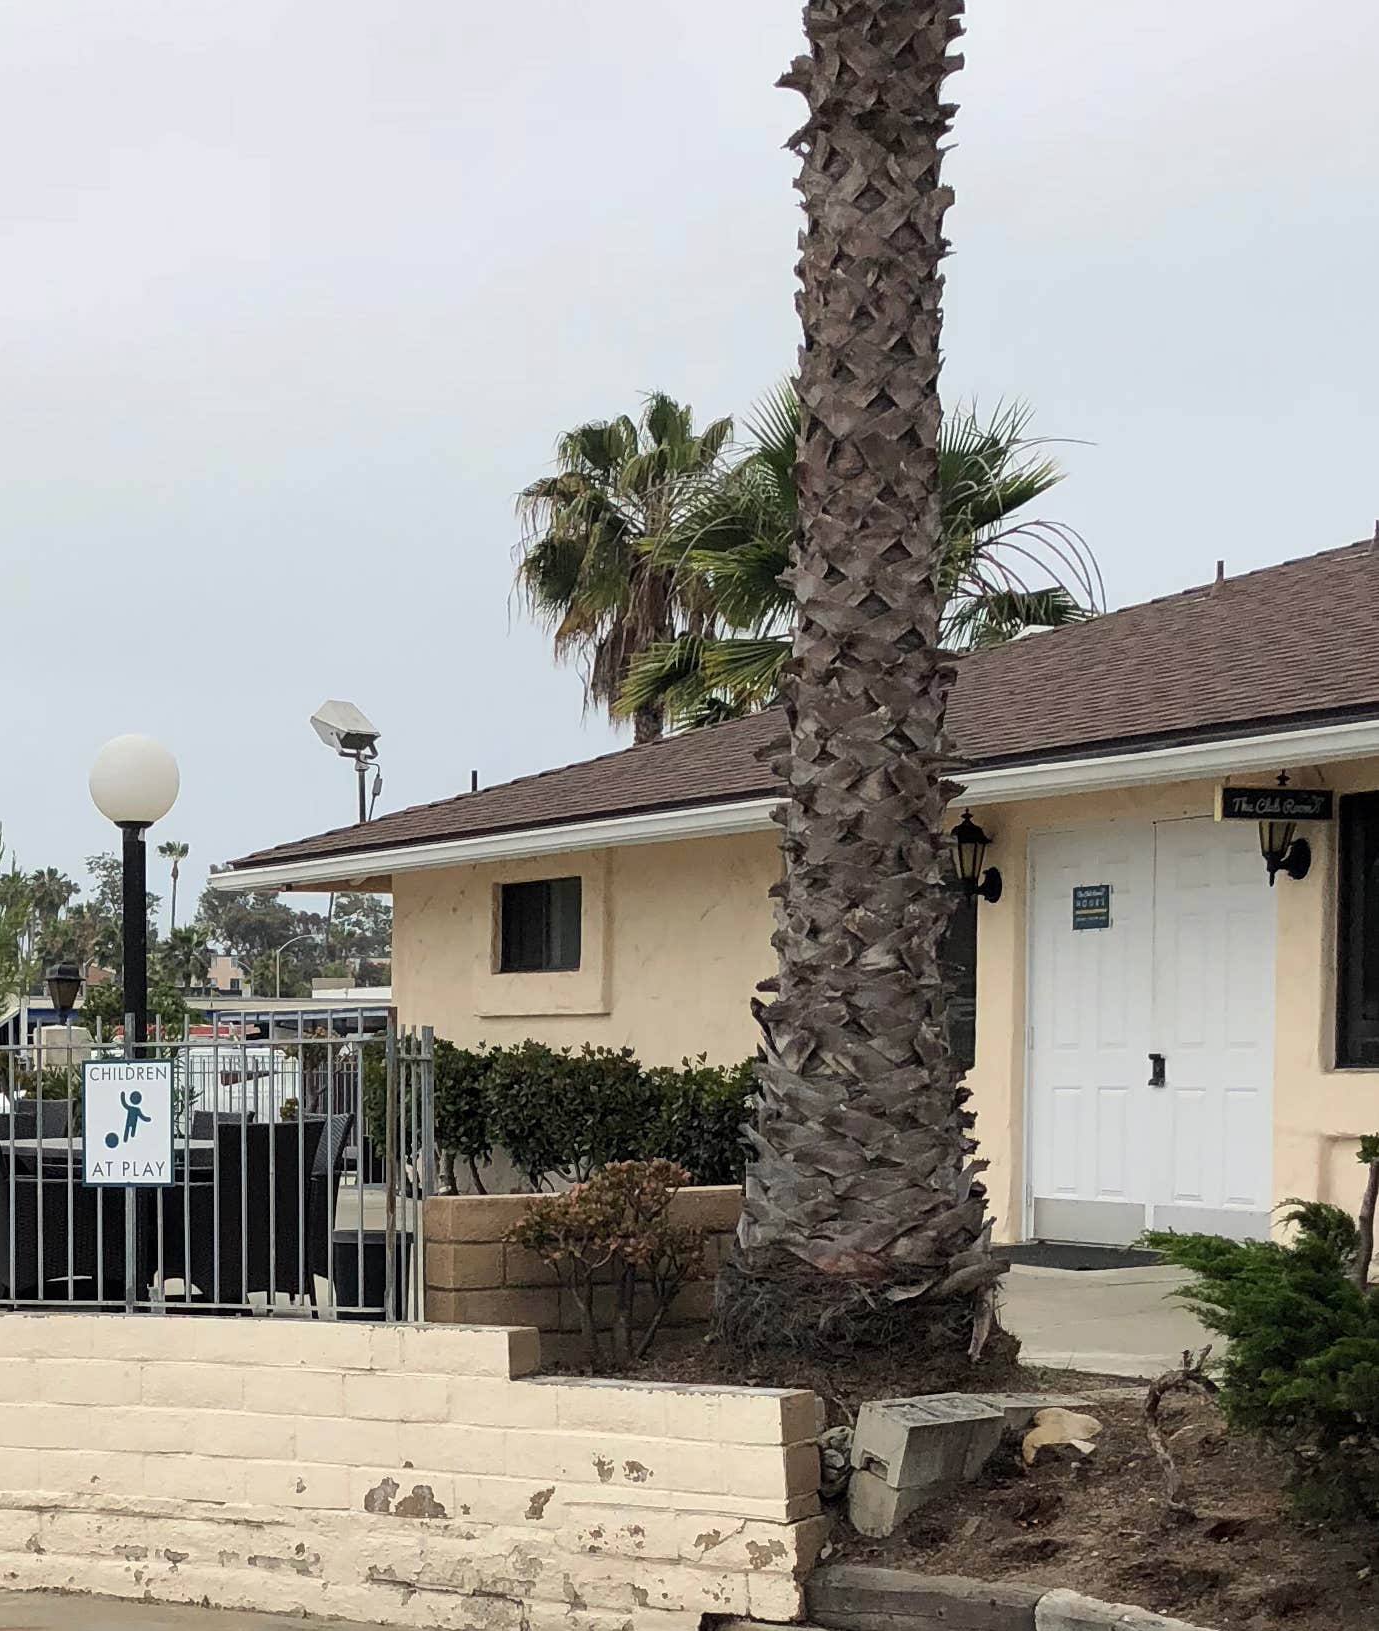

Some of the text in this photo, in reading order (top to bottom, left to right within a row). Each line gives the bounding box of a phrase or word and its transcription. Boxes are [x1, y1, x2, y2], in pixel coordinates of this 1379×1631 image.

[89, 1066, 167, 1081] CHILDREN
[92, 1161, 166, 1177] AT PLAY
